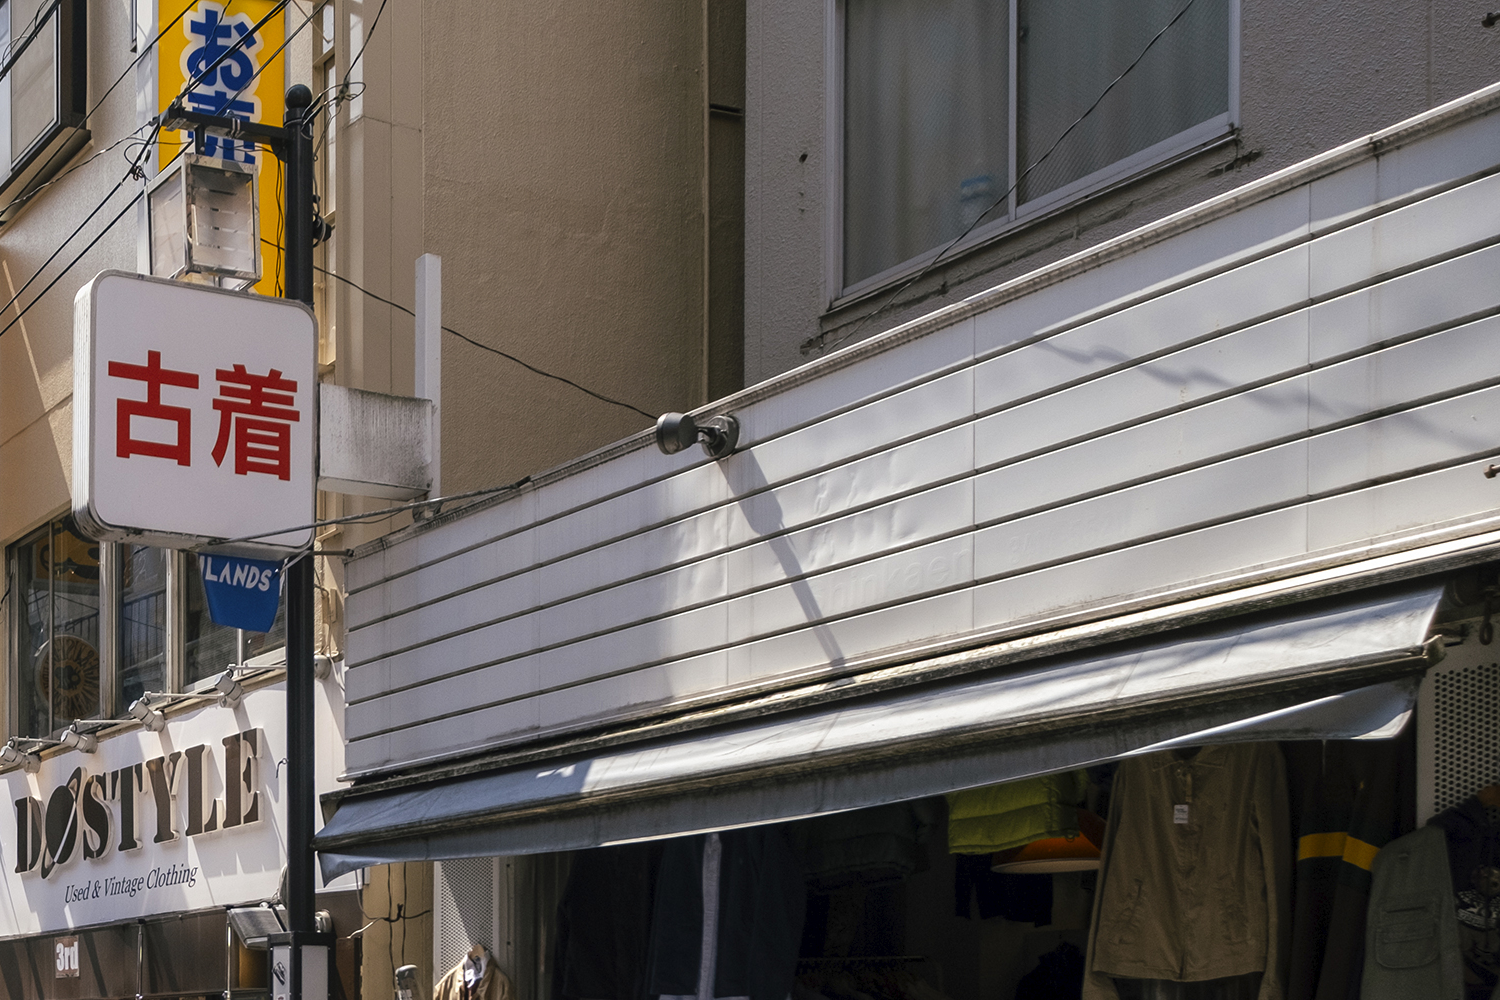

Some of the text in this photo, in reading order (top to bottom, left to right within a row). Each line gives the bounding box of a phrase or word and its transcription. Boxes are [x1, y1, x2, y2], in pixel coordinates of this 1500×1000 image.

[108, 350, 301, 482] 古着
[65, 863, 198, 903] Used & Vintage Clothing
[56, 941, 78, 972] 3rd
